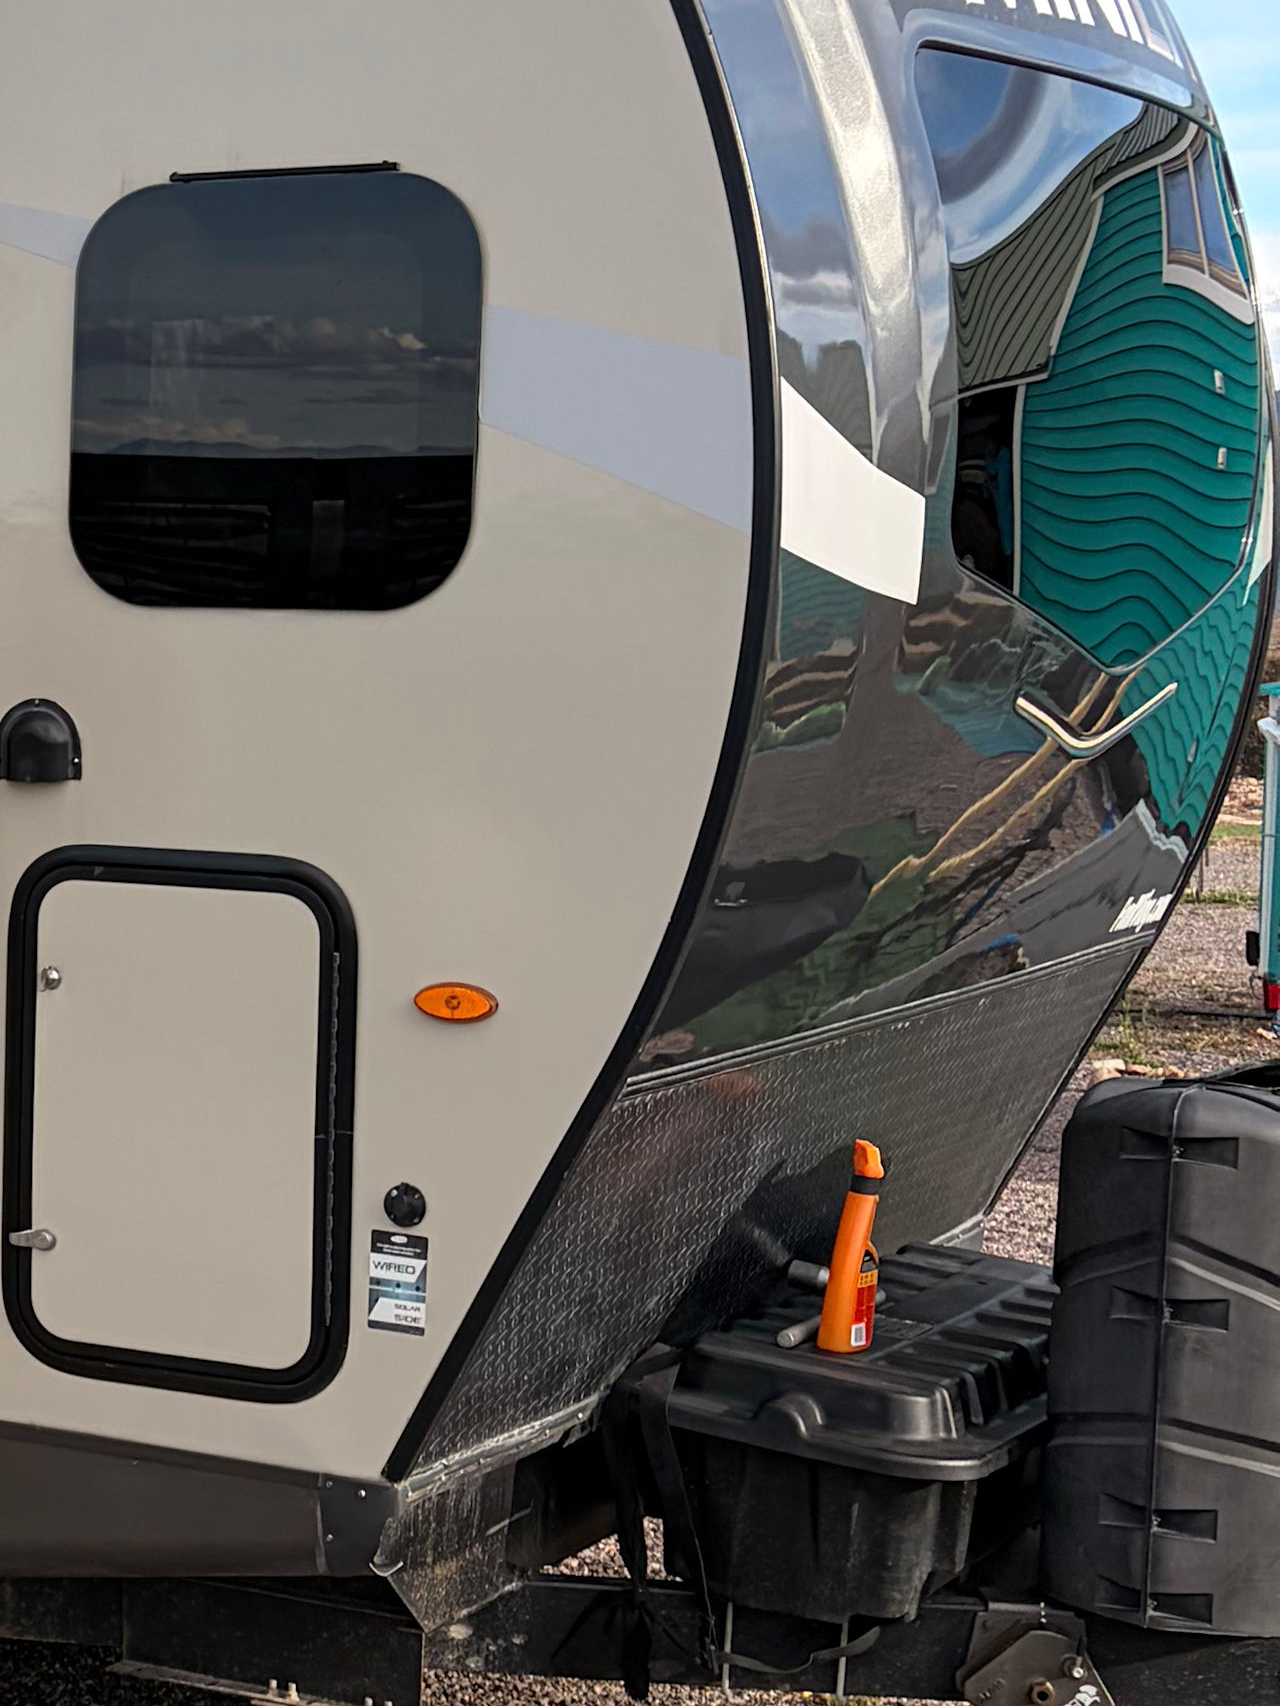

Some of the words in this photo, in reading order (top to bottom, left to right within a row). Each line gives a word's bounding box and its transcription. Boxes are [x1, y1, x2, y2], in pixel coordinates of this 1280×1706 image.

[372, 1260, 416, 1275] WIRED
[394, 1303, 421, 1312] SOLAR
[394, 1314, 422, 1324] SIDE
